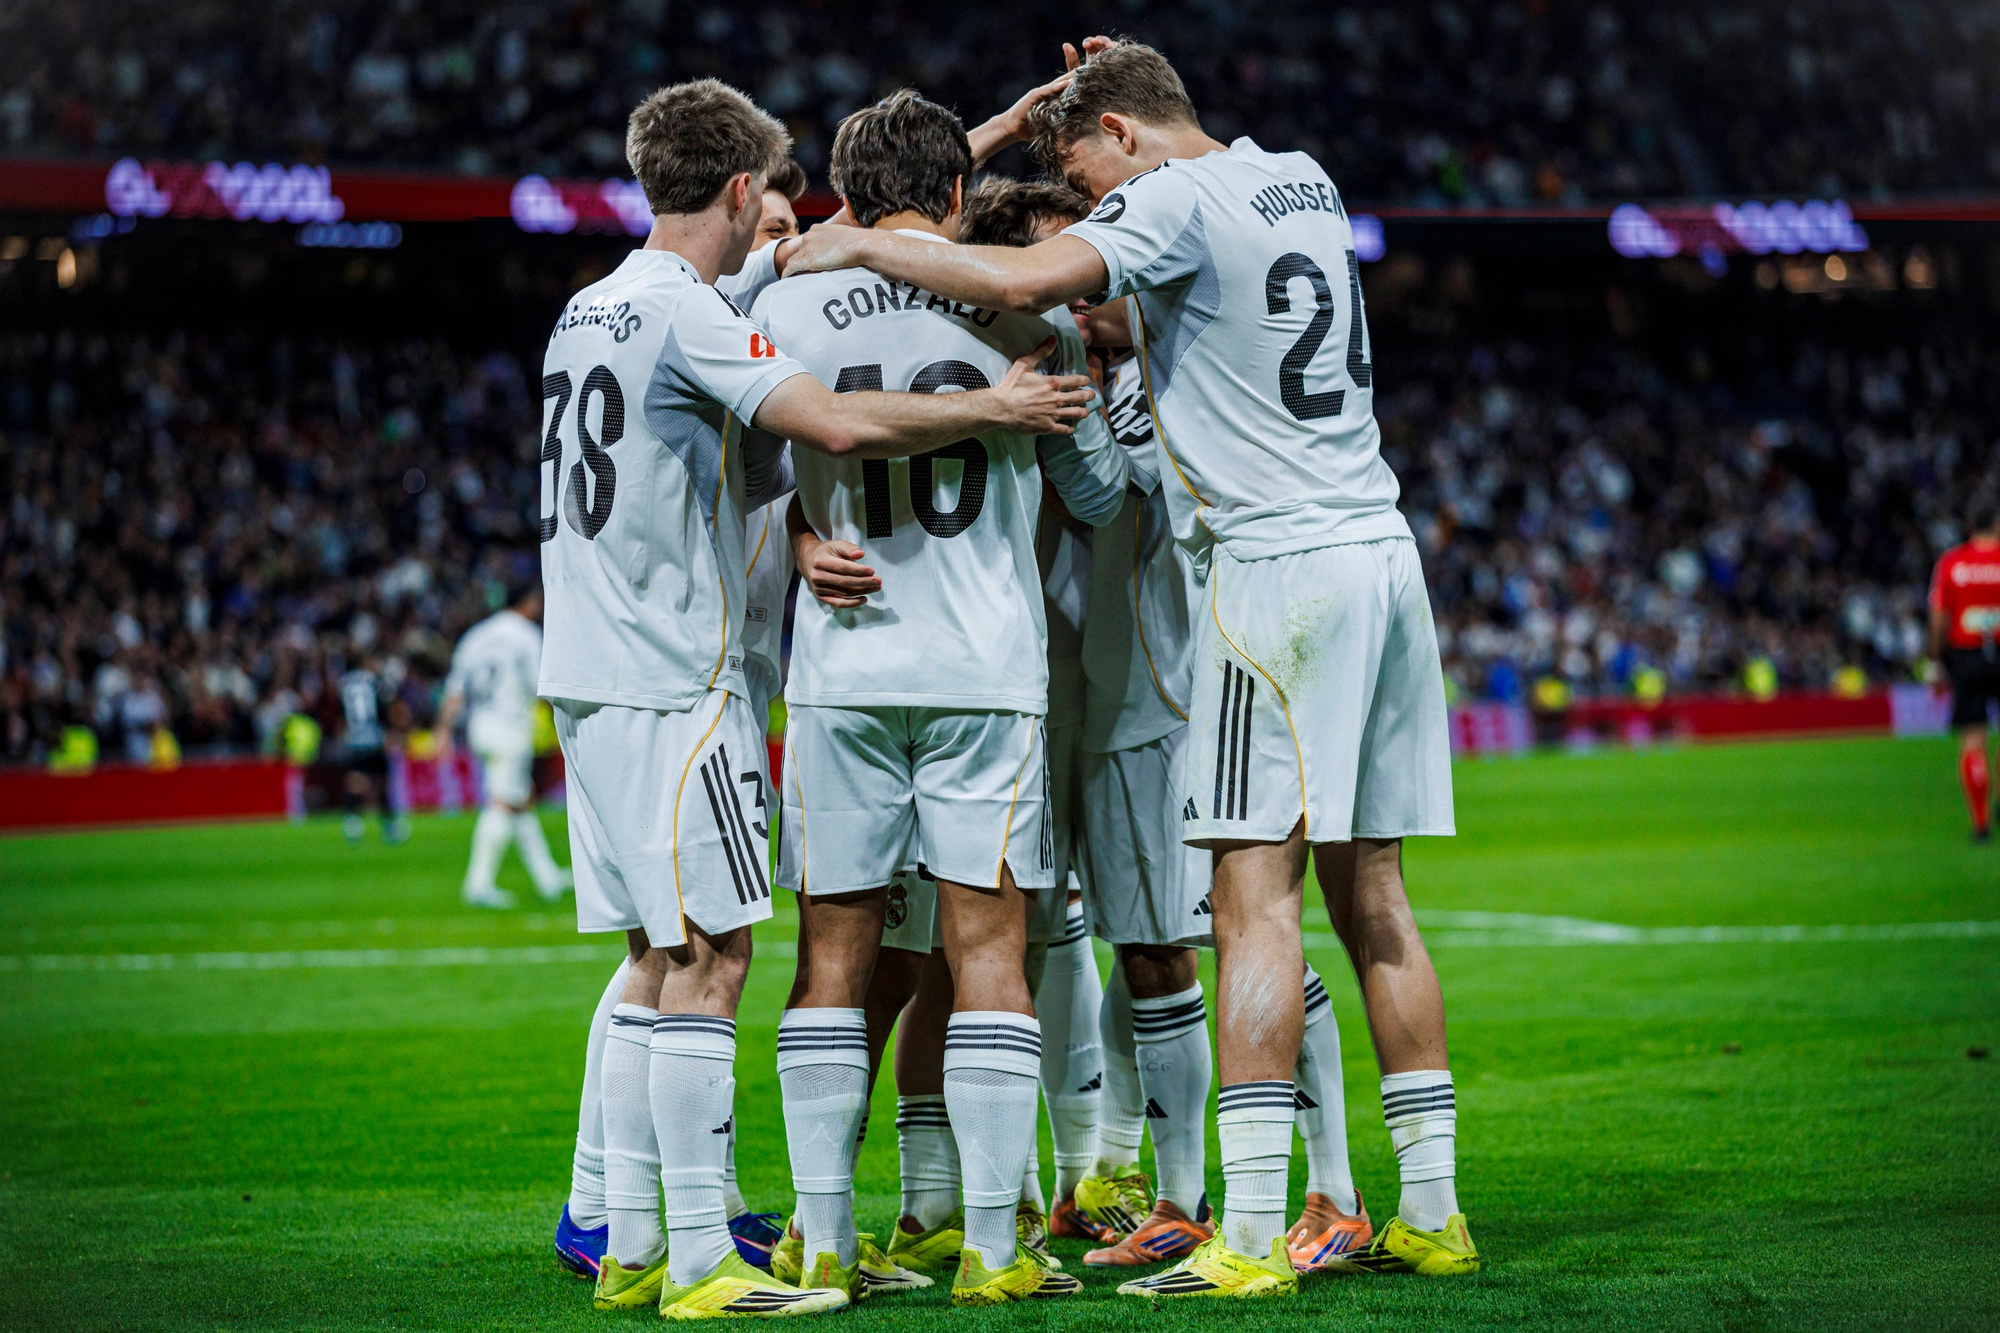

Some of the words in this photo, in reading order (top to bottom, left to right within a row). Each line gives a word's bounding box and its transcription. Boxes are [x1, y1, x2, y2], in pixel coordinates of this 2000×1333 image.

[1250, 182, 1345, 228] HUIJSEN
[541, 364, 625, 541] 38
[834, 359, 990, 540] 16
